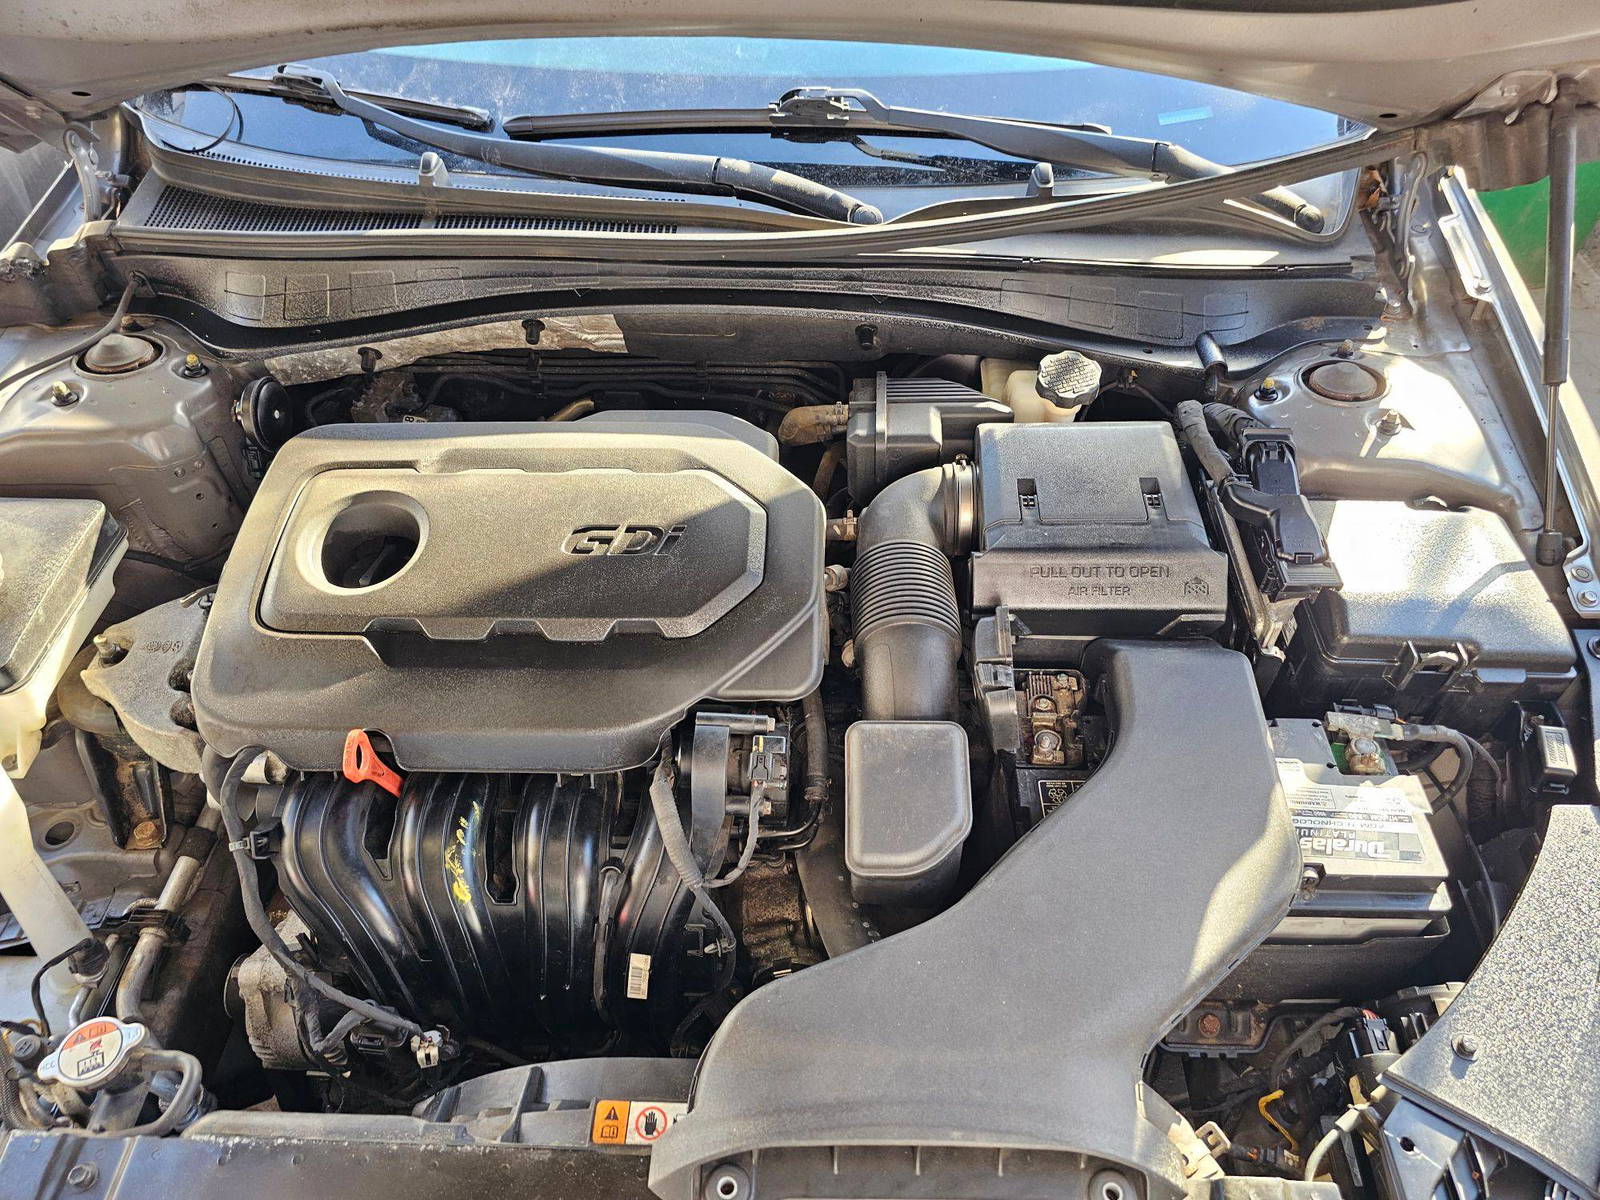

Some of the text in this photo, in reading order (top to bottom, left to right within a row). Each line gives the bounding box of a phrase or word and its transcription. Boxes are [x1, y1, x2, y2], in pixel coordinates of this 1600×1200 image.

[561, 524, 687, 555] GDi
[1030, 565, 1170, 578] PULL OUT TO OPEN
[1068, 585, 1131, 596] AIR FILTER
[1295, 828, 1356, 840] PLATINU
[1299, 837, 1392, 858] Duralas
